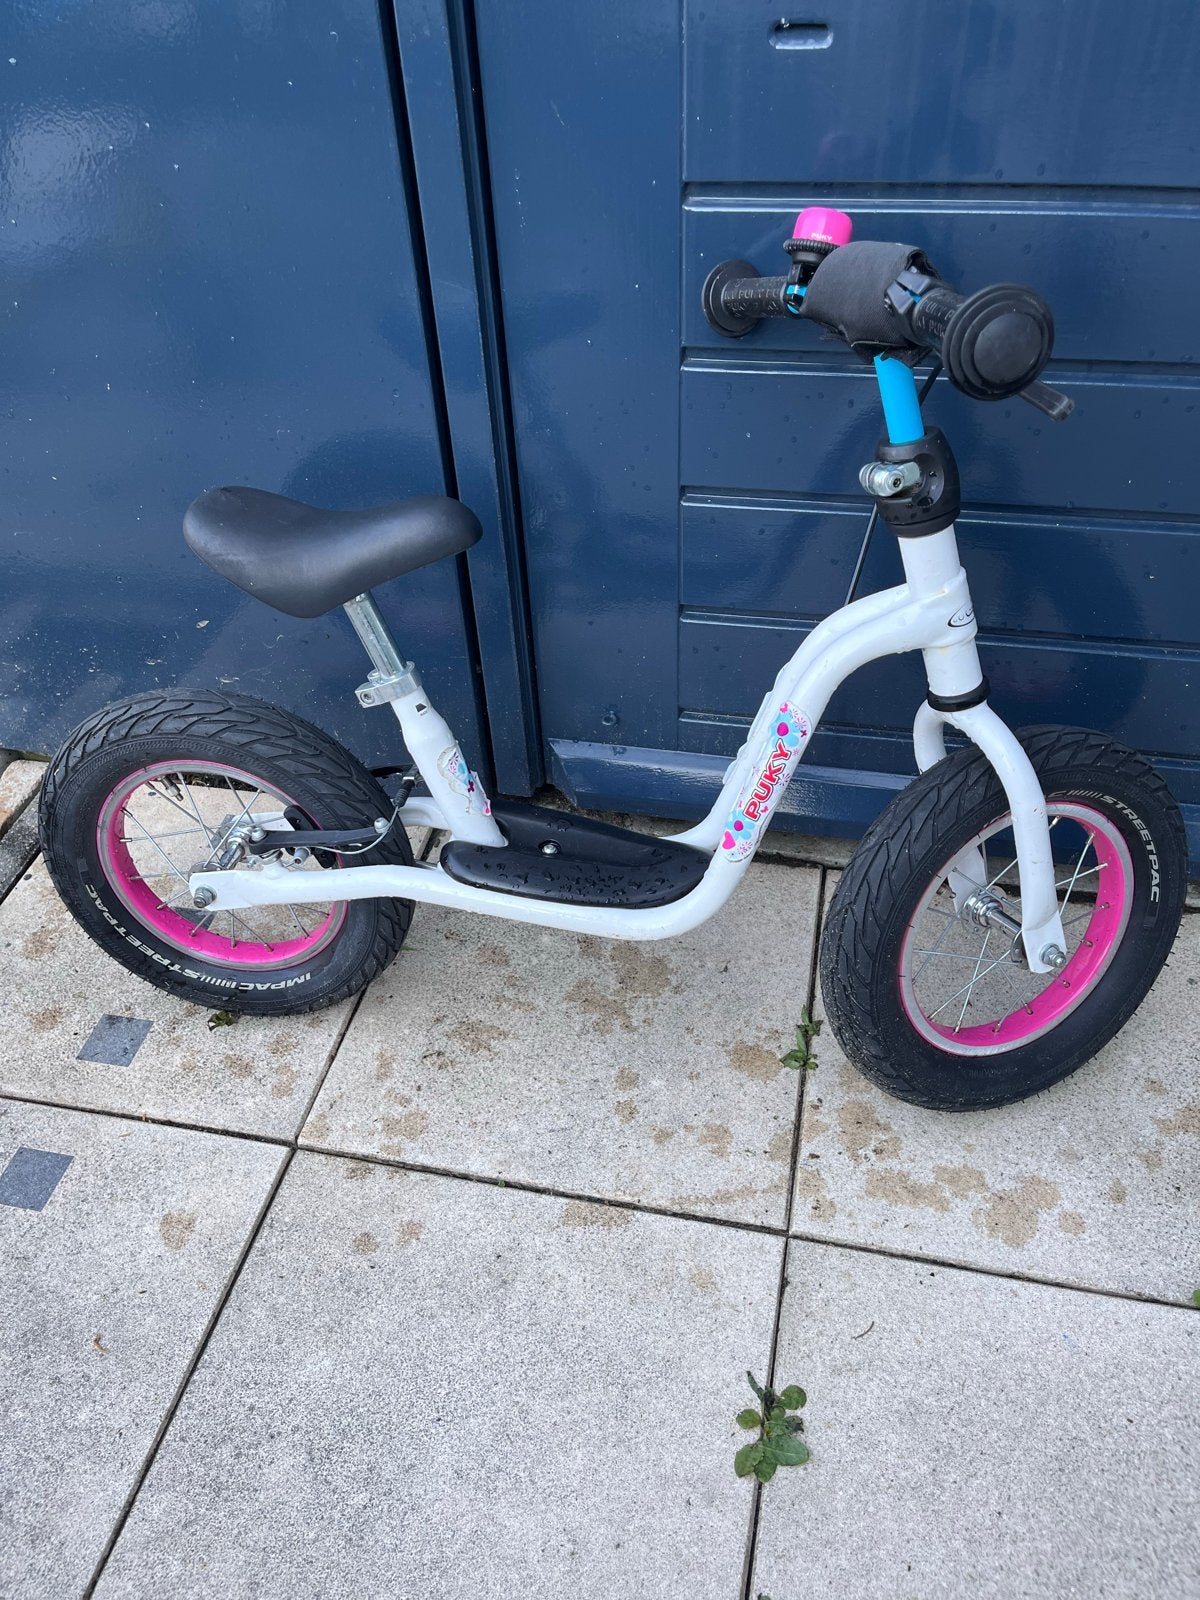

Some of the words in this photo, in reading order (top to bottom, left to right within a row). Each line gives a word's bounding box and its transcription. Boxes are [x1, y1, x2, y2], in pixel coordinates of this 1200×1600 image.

[810, 232, 833, 241] PUKY
[744, 738, 791, 822] PUKY
[1100, 794, 1160, 903] STREETPAC
[85, 884, 201, 980] STREETPAC
[238, 972, 312, 991] IMPAC
